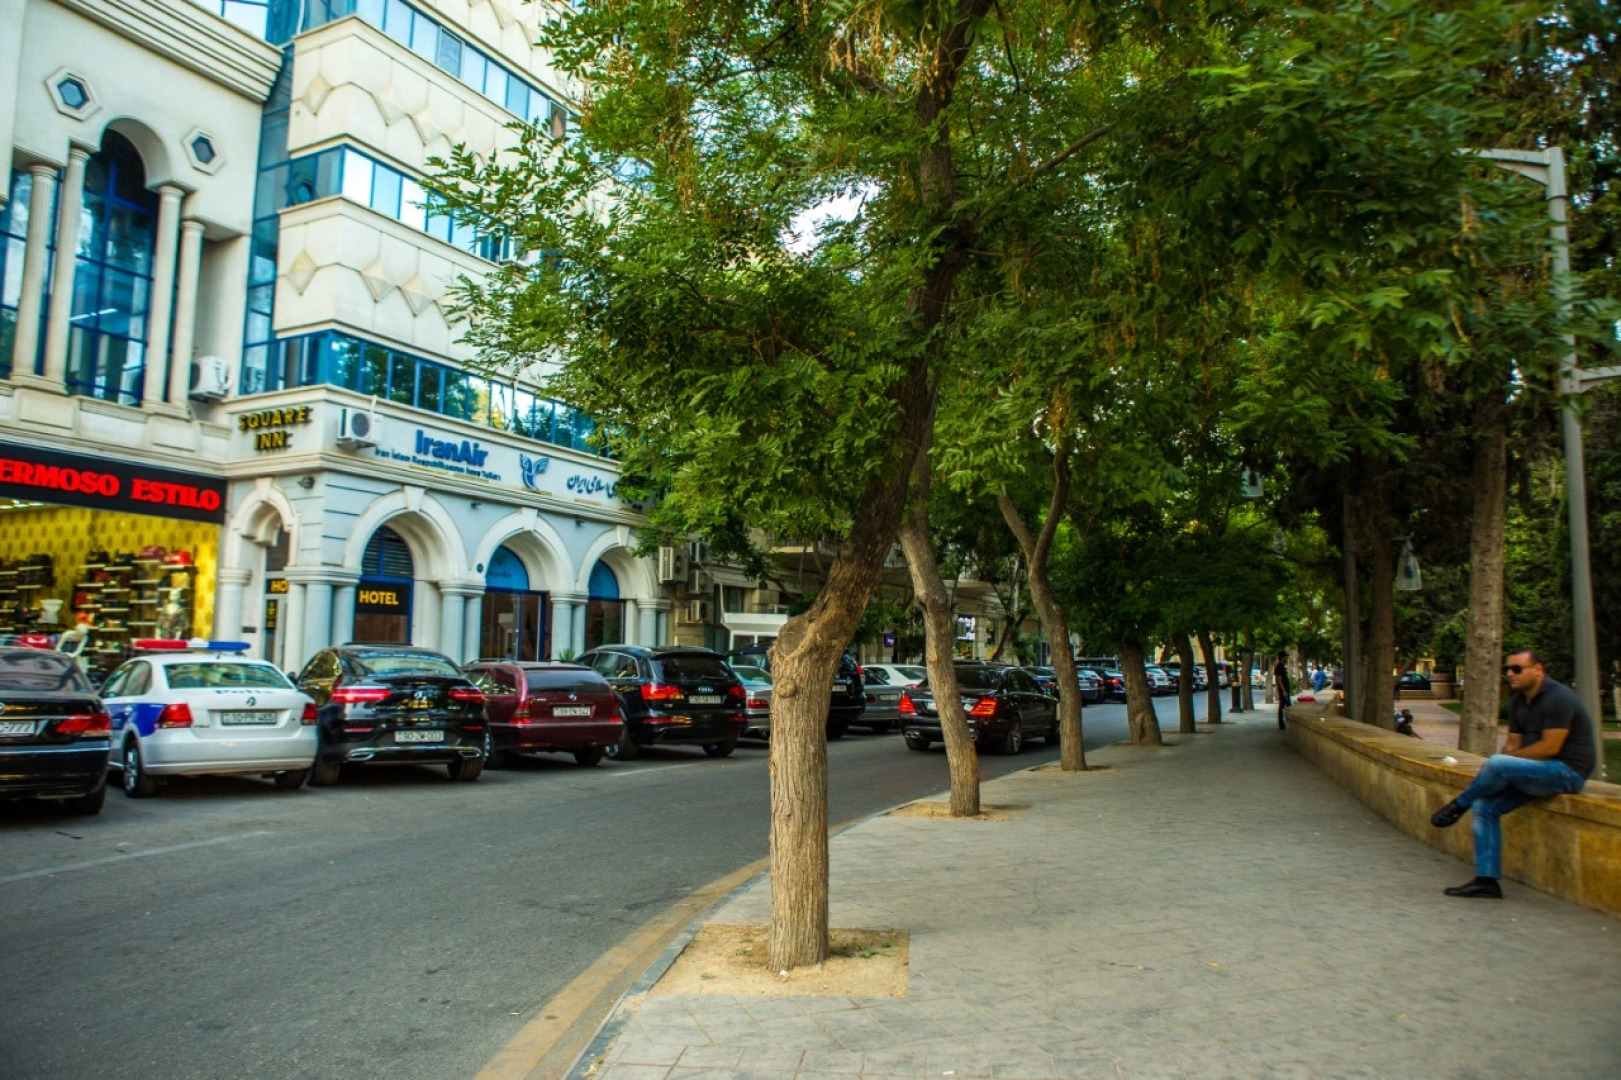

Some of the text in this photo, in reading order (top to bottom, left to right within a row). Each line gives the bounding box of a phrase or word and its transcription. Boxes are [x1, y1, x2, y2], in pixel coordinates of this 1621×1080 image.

[238, 406, 309, 431] SQUARE
[254, 431, 287, 451] INN
[416, 429, 488, 467] IranAir
[132, 478, 220, 511] ESTILO
[359, 590, 399, 605] HOTEL
